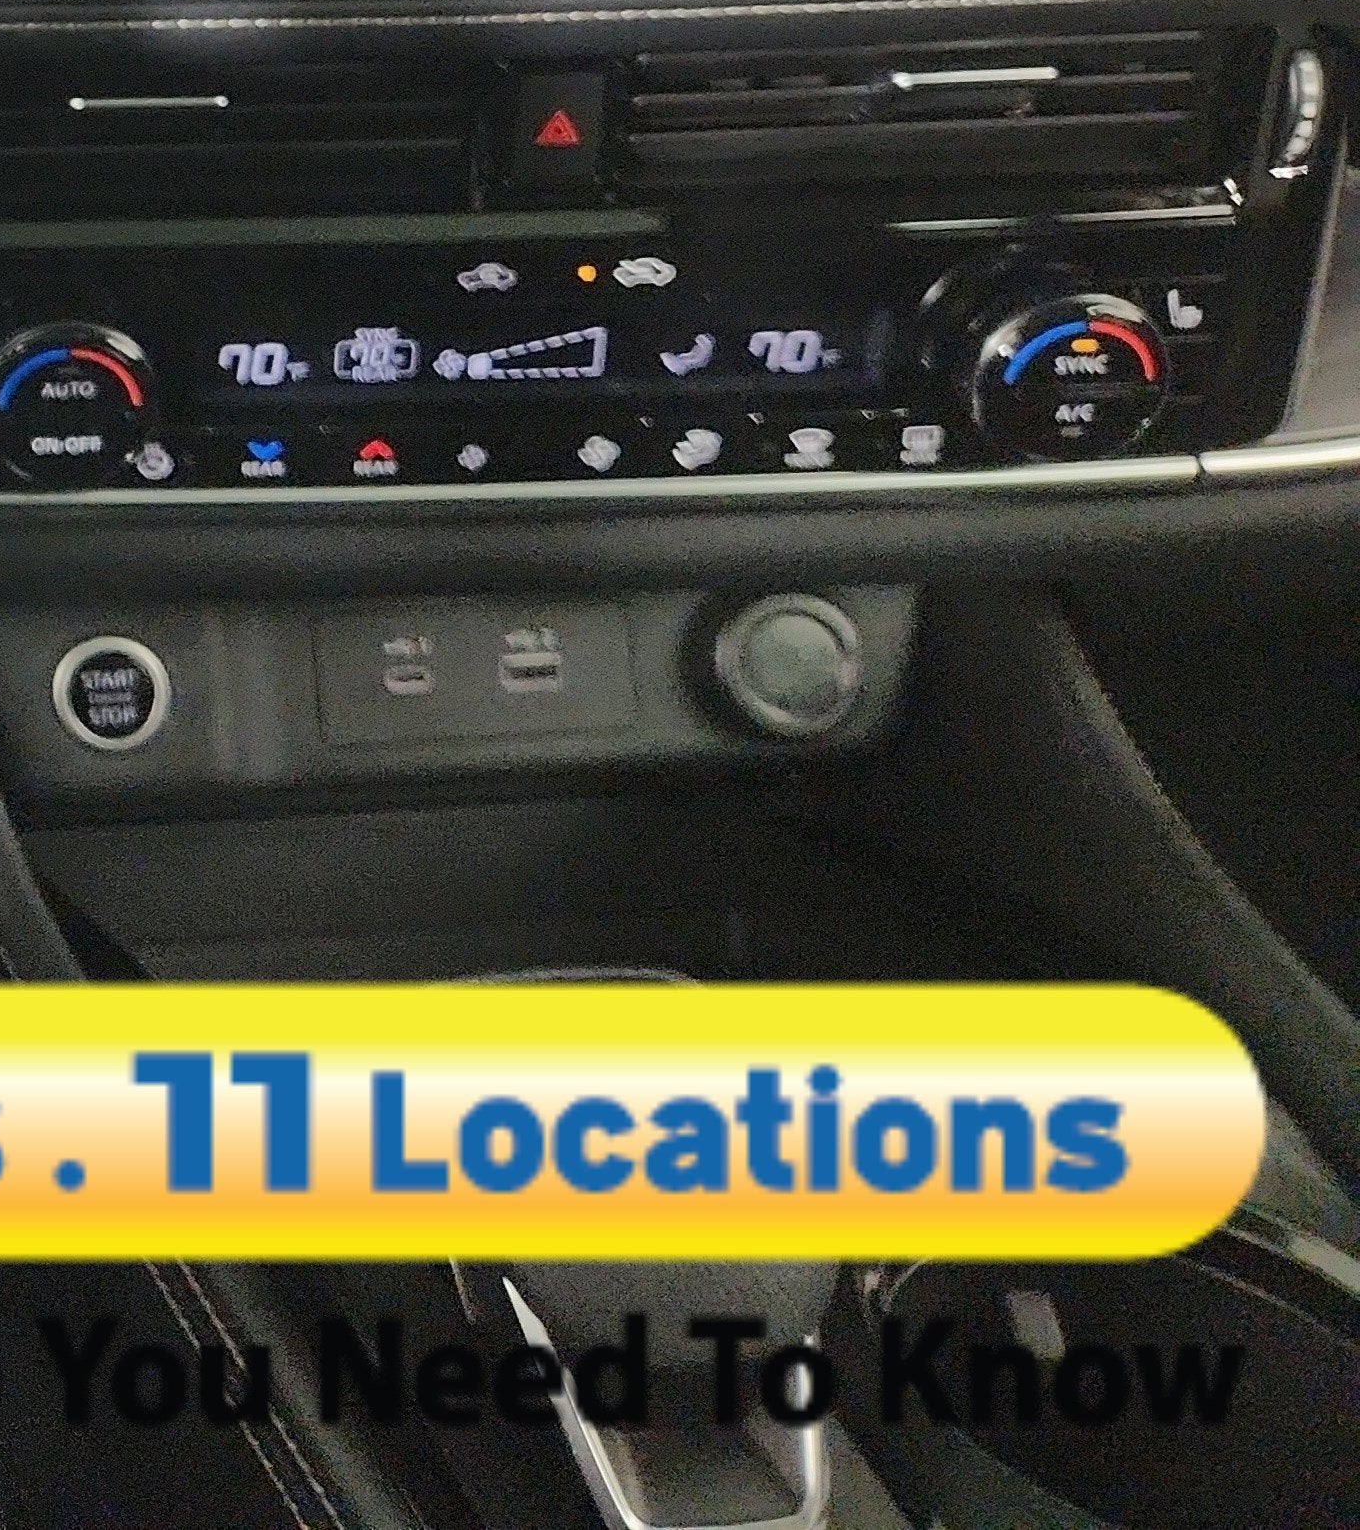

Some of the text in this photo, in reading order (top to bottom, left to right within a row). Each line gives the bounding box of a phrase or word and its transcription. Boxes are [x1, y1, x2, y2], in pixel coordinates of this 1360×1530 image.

[1053, 353, 1110, 376] SYNC
[40, 379, 98, 401] AUTO
[1054, 403, 1095, 424] A/C
[81, 669, 138, 690] START
